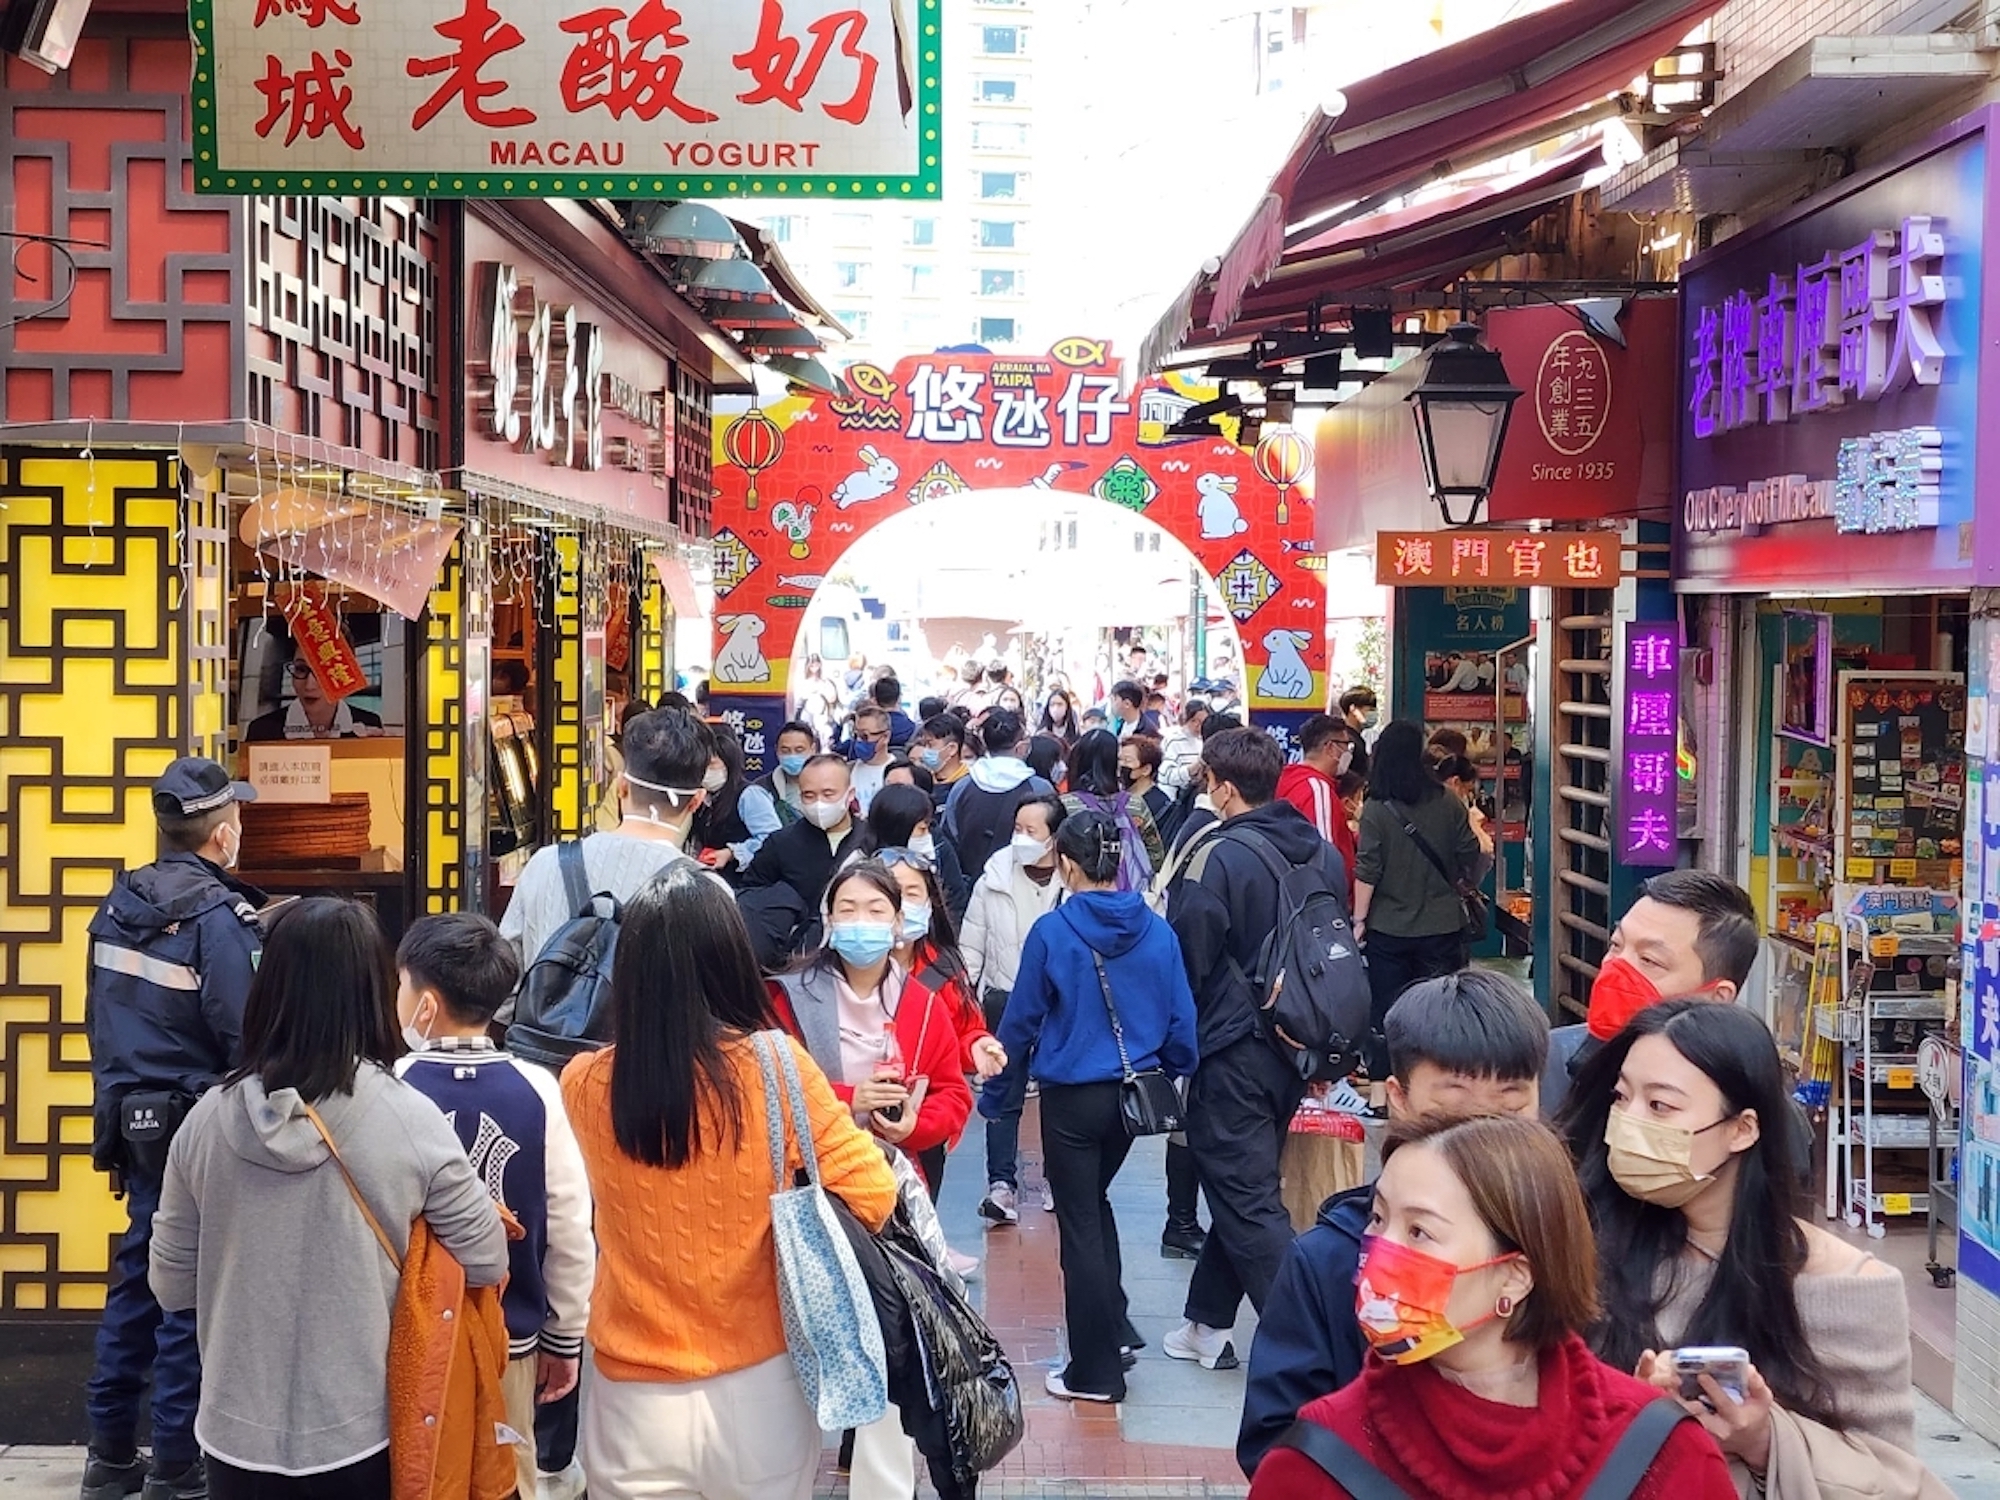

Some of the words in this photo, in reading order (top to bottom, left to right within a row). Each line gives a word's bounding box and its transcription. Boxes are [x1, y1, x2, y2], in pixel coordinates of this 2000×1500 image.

[406, 0, 878, 131] 老酸奶
[490, 141, 624, 166] MACAU
[663, 141, 821, 167] YOGURT
[992, 362, 1035, 373] ARRAIAL
[1036, 363, 1051, 373] NA
[993, 374, 1033, 387] TAIPA
[1548, 345, 1571, 437] 年創業
[1531, 462, 1572, 481] Since
[1577, 461, 1615, 481] 1935
[1393, 538, 1601, 579] 澳門官也
[1628, 634, 1673, 852] 車厘哥夫
